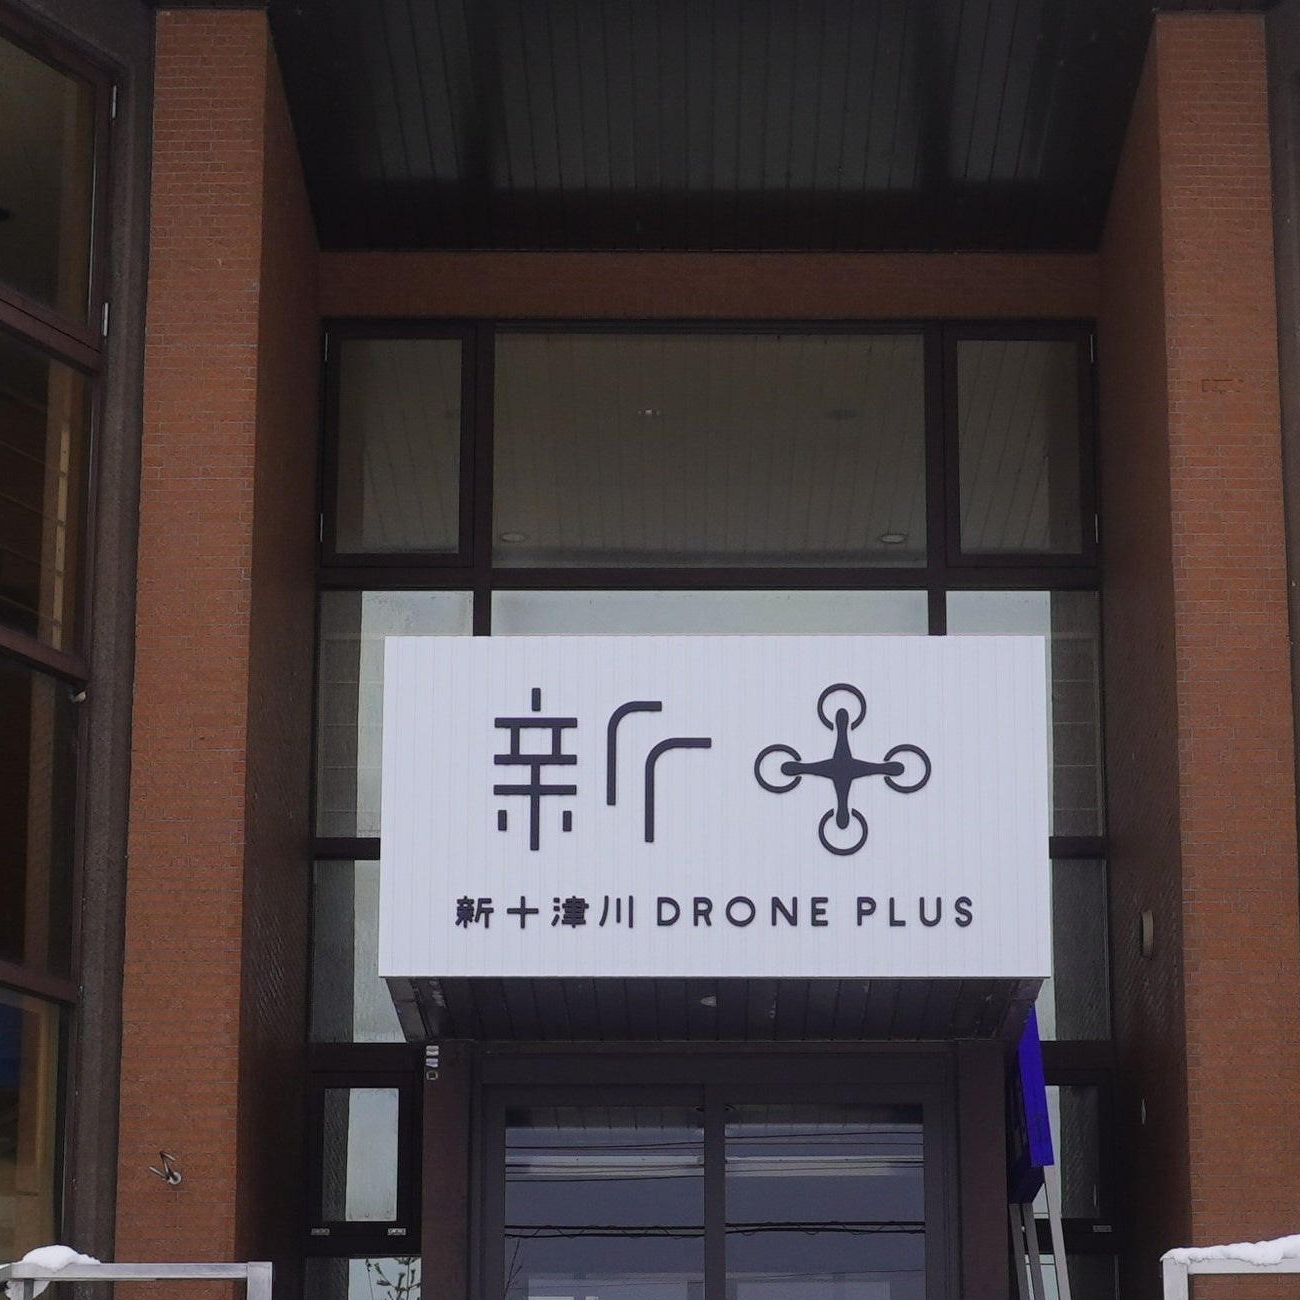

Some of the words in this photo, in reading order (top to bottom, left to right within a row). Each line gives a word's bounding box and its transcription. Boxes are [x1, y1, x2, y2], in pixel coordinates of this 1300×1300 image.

[455, 894, 635, 930] 新十津川
[656, 895, 829, 929] DRONE
[856, 895, 974, 929] PLUS
